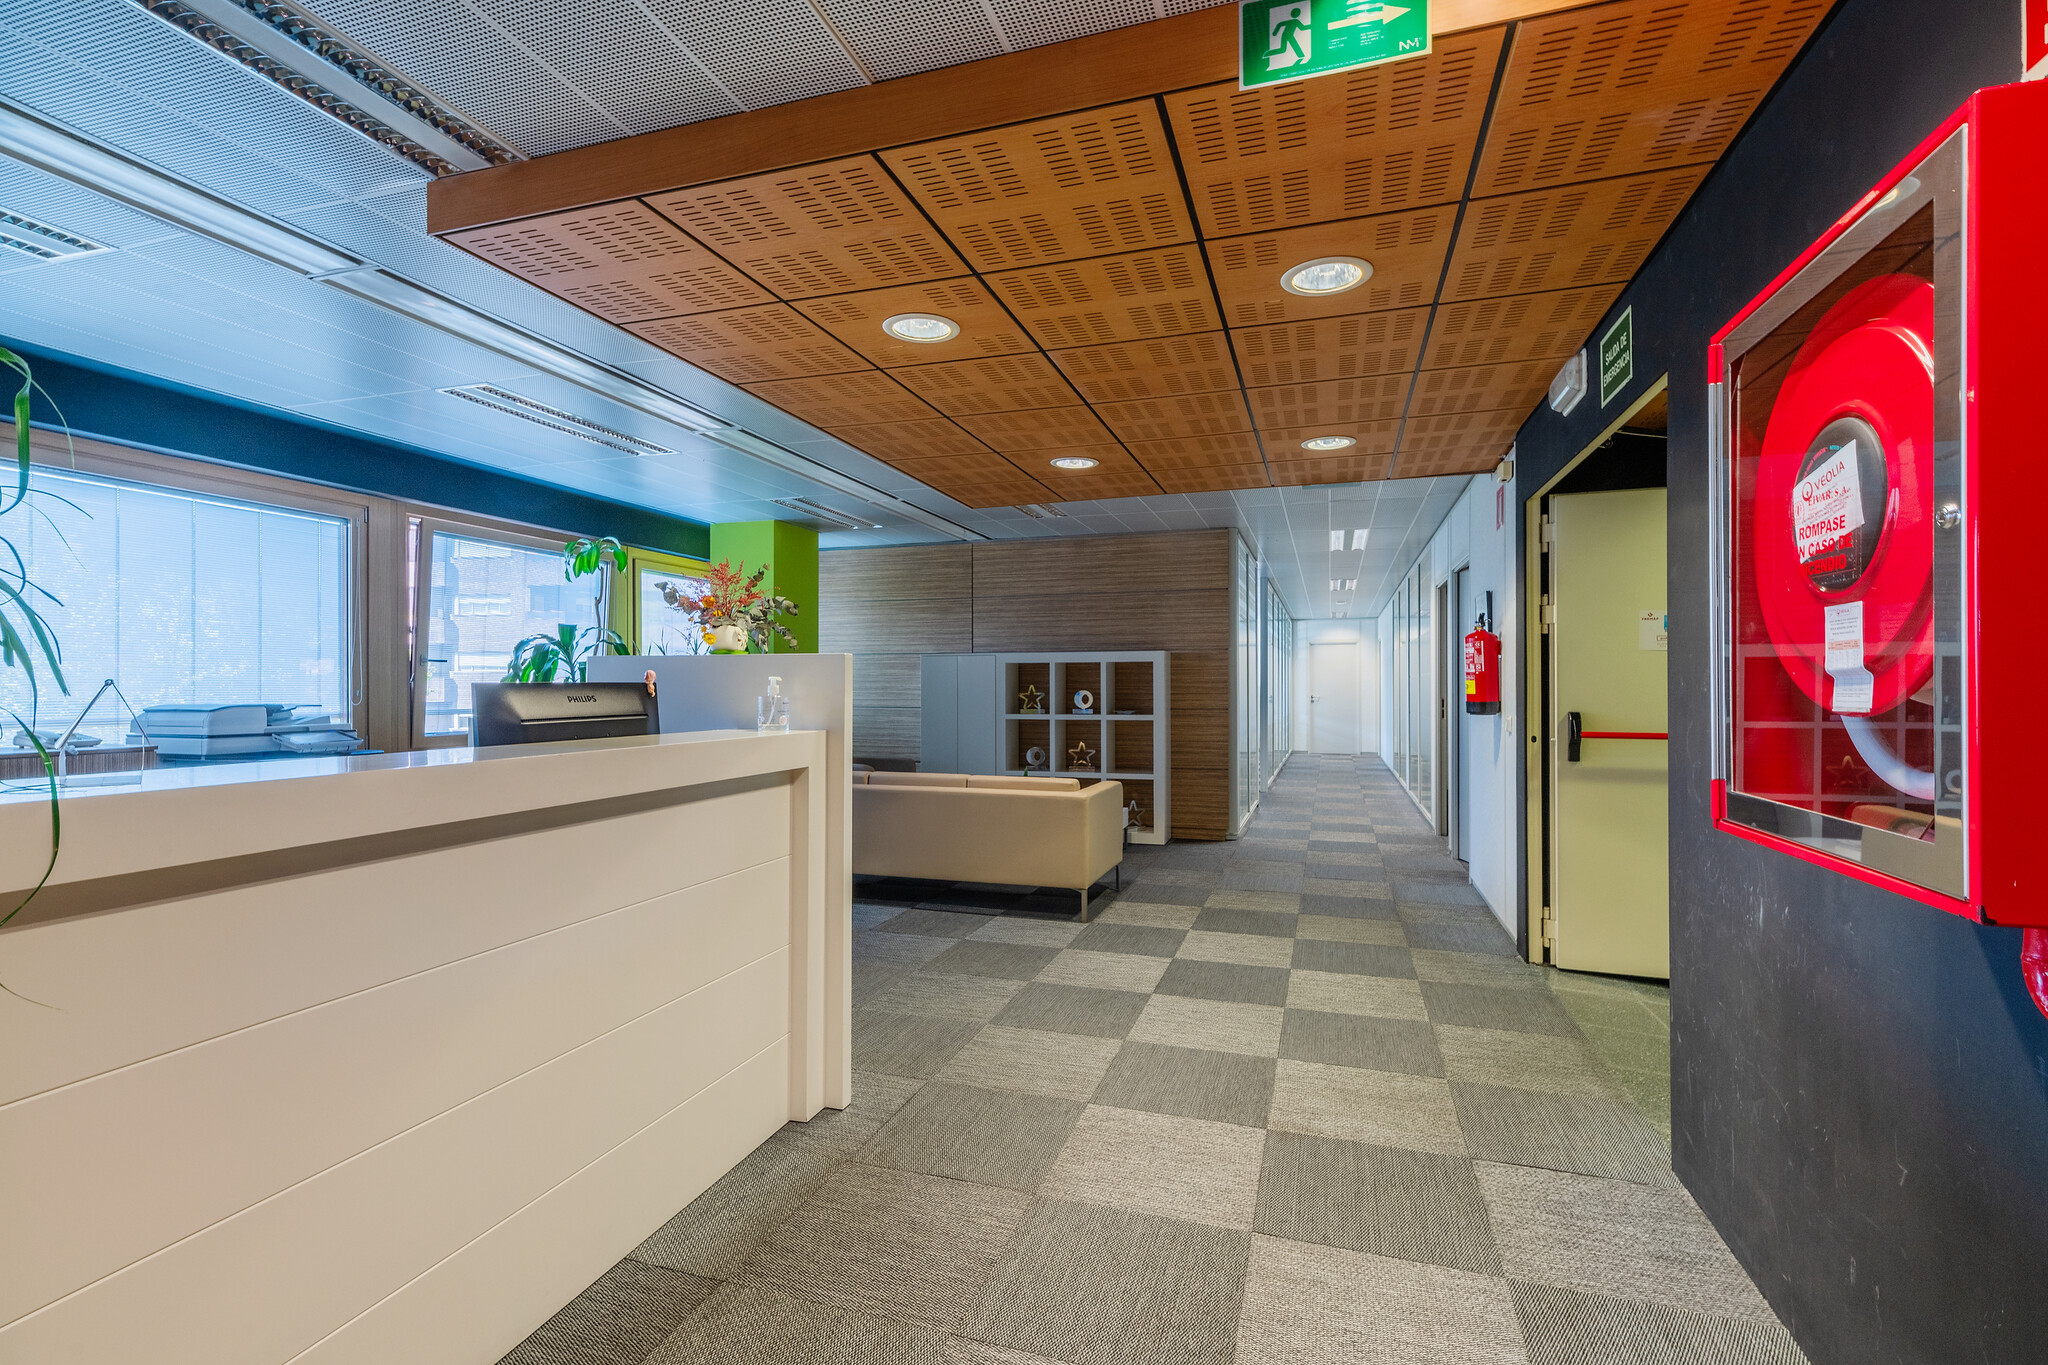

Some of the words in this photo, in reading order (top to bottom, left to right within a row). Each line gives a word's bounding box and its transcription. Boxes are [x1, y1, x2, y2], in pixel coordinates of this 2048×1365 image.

[1605, 341, 1620, 366] SALIDA
[1620, 332, 1627, 349] DE
[1603, 350, 1630, 387] EMERGENCIA
[1814, 461, 1845, 490] VEOLIA
[1799, 514, 1846, 541] ROMPASE
[1808, 537, 1836, 557] CASO
[1838, 531, 1853, 550] DE
[567, 695, 597, 703] PHILIPS
